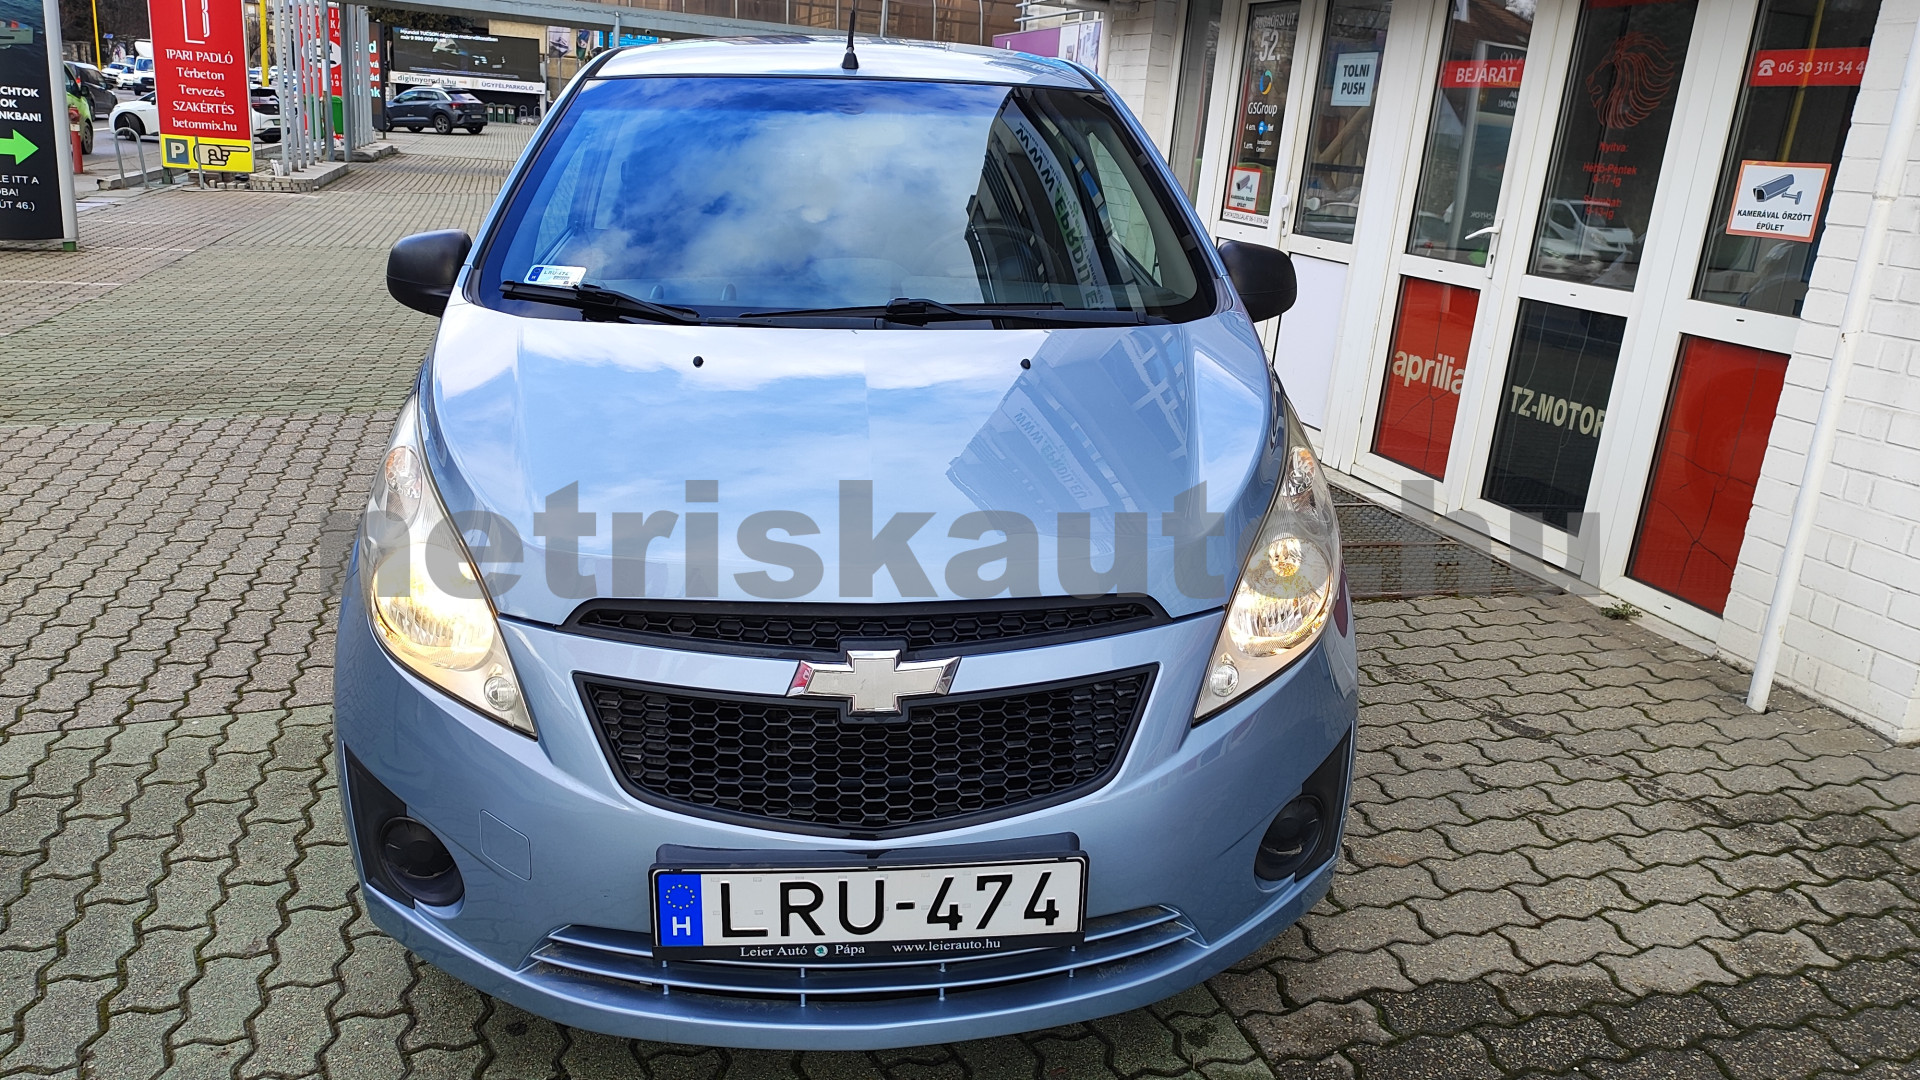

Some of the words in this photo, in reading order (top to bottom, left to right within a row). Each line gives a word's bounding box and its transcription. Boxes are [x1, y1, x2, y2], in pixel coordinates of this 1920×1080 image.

[1259, 29, 1280, 61] 52.
[166, 48, 193, 61] IPARI
[196, 51, 234, 64] PADLÓ
[176, 66, 224, 80] Térbeton
[1343, 63, 1370, 78] TOLNI
[1455, 63, 1517, 83] BEJÁRAT
[1778, 60, 1795, 73] 06
[1795, 61, 1813, 75] 30
[1814, 61, 1834, 76] 311
[1834, 60, 1853, 75] 34
[178, 84, 225, 97] Tervezés
[481, 81, 534, 91] ÜGYFÉLPARKOLÓ
[1340, 82, 1366, 95] PUSH
[172, 100, 235, 114] SZAKÉRTÉS
[1247, 101, 1278, 117] GSGroup
[172, 117, 237, 132] betonmix.hu
[170, 142, 185, 159] P
[12, 175, 28, 184] ITT
[31, 176, 39, 184] A
[15, 201, 35, 211] 46.)
[1737, 209, 1779, 219] KAMERÁVAL
[1781, 211, 1812, 221] ŐRZÖTT
[1756, 222, 1784, 231] ÉPÜLET
[1392, 350, 1465, 395] aprilia
[719, 871, 1060, 938] LRU-474
[672, 916, 691, 936] H
[739, 946, 776, 957] Leier
[778, 944, 808, 956] Autó
[835, 943, 866, 956] Pápa
[892, 938, 1001, 952] www.leierauto.hu
